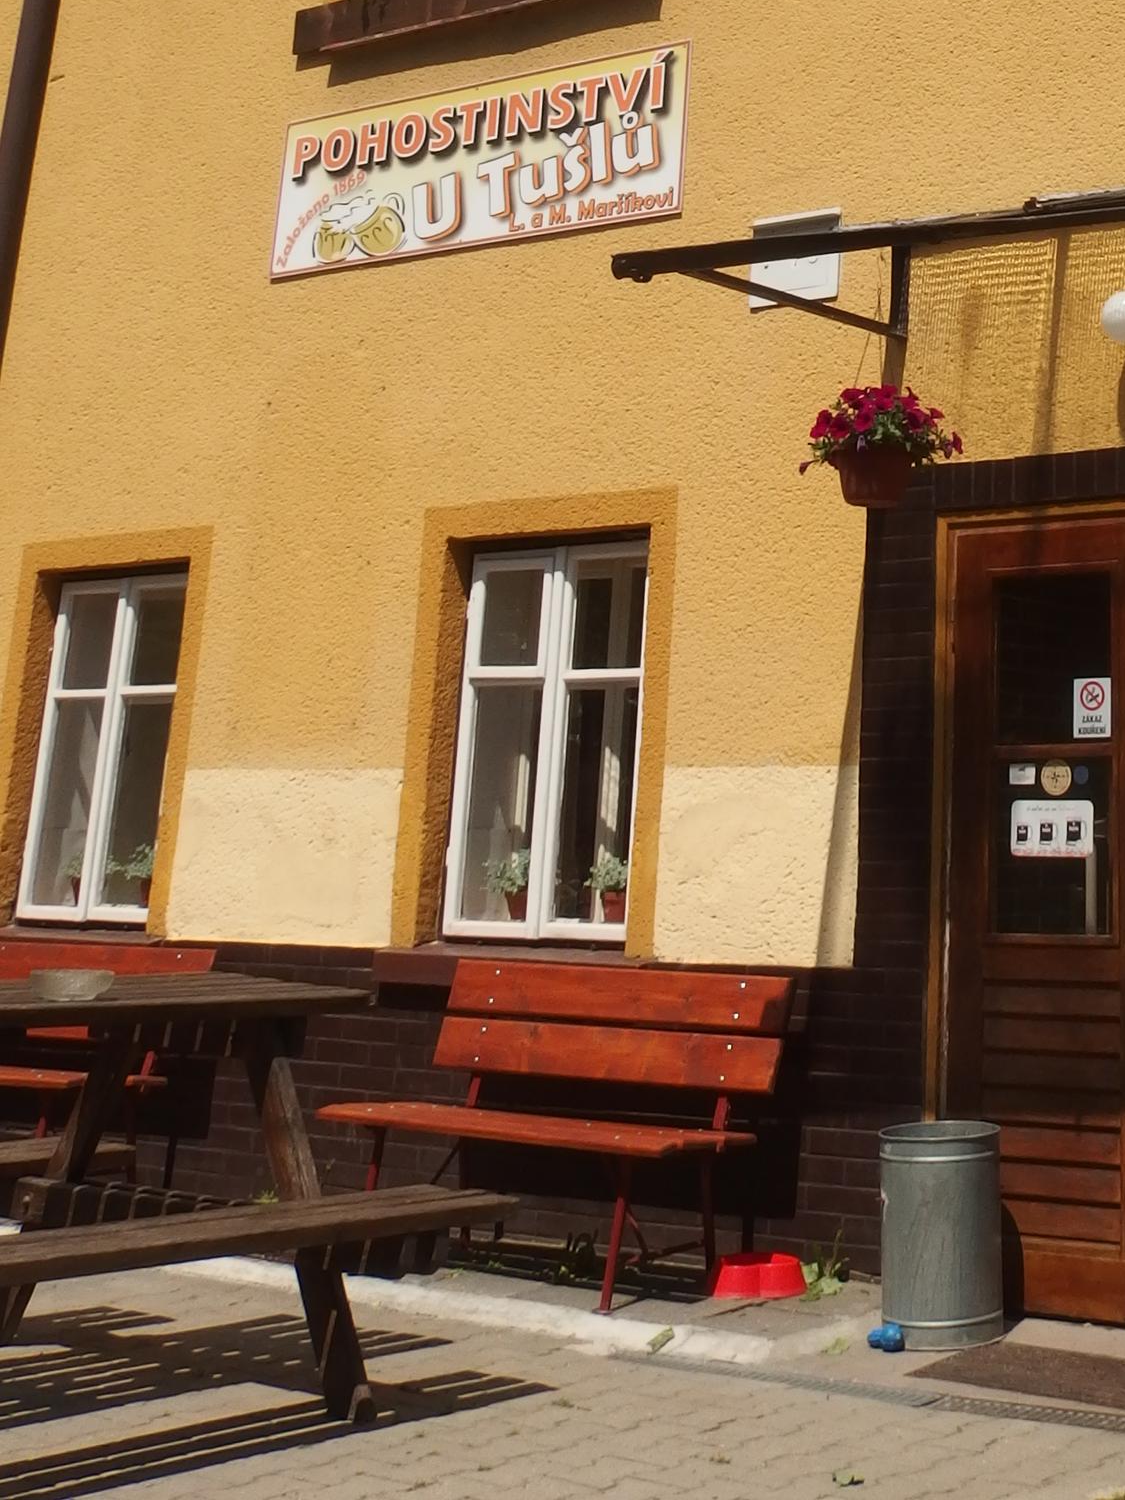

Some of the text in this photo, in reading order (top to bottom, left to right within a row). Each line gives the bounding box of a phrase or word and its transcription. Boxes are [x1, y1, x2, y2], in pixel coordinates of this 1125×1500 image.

[291, 50, 675, 179] POHOSTINSTVÍ
[276, 170, 367, 268] Založeno 1869
[412, 110, 660, 242] U Tušlů
[509, 213, 525, 232] L.
[531, 212, 544, 228] a
[549, 203, 571, 225] M.
